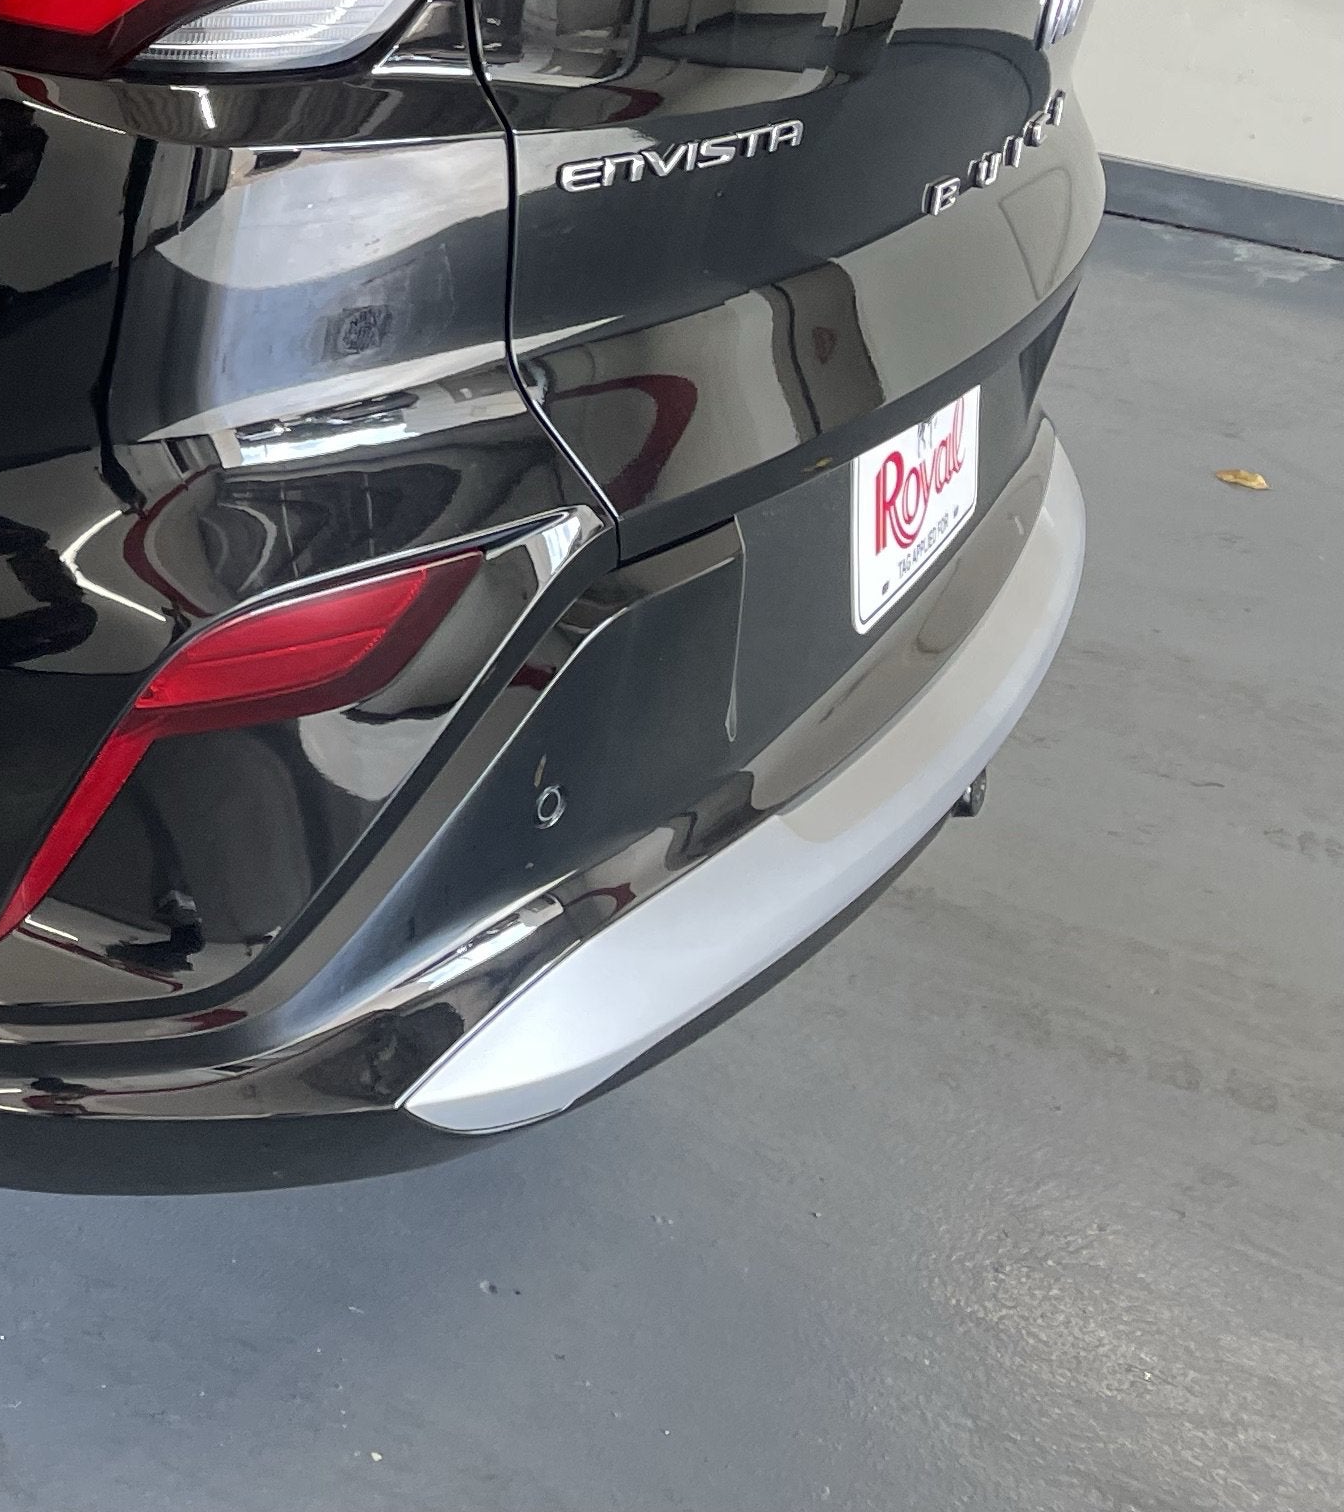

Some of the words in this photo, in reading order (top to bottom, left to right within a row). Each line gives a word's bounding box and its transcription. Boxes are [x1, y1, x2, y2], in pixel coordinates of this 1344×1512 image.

[556, 118, 806, 194] ENVISTA
[874, 394, 967, 557] Royal
[896, 553, 912, 580] TAG
[912, 531, 937, 567] APPLIED
[937, 511, 950, 542] FOR
